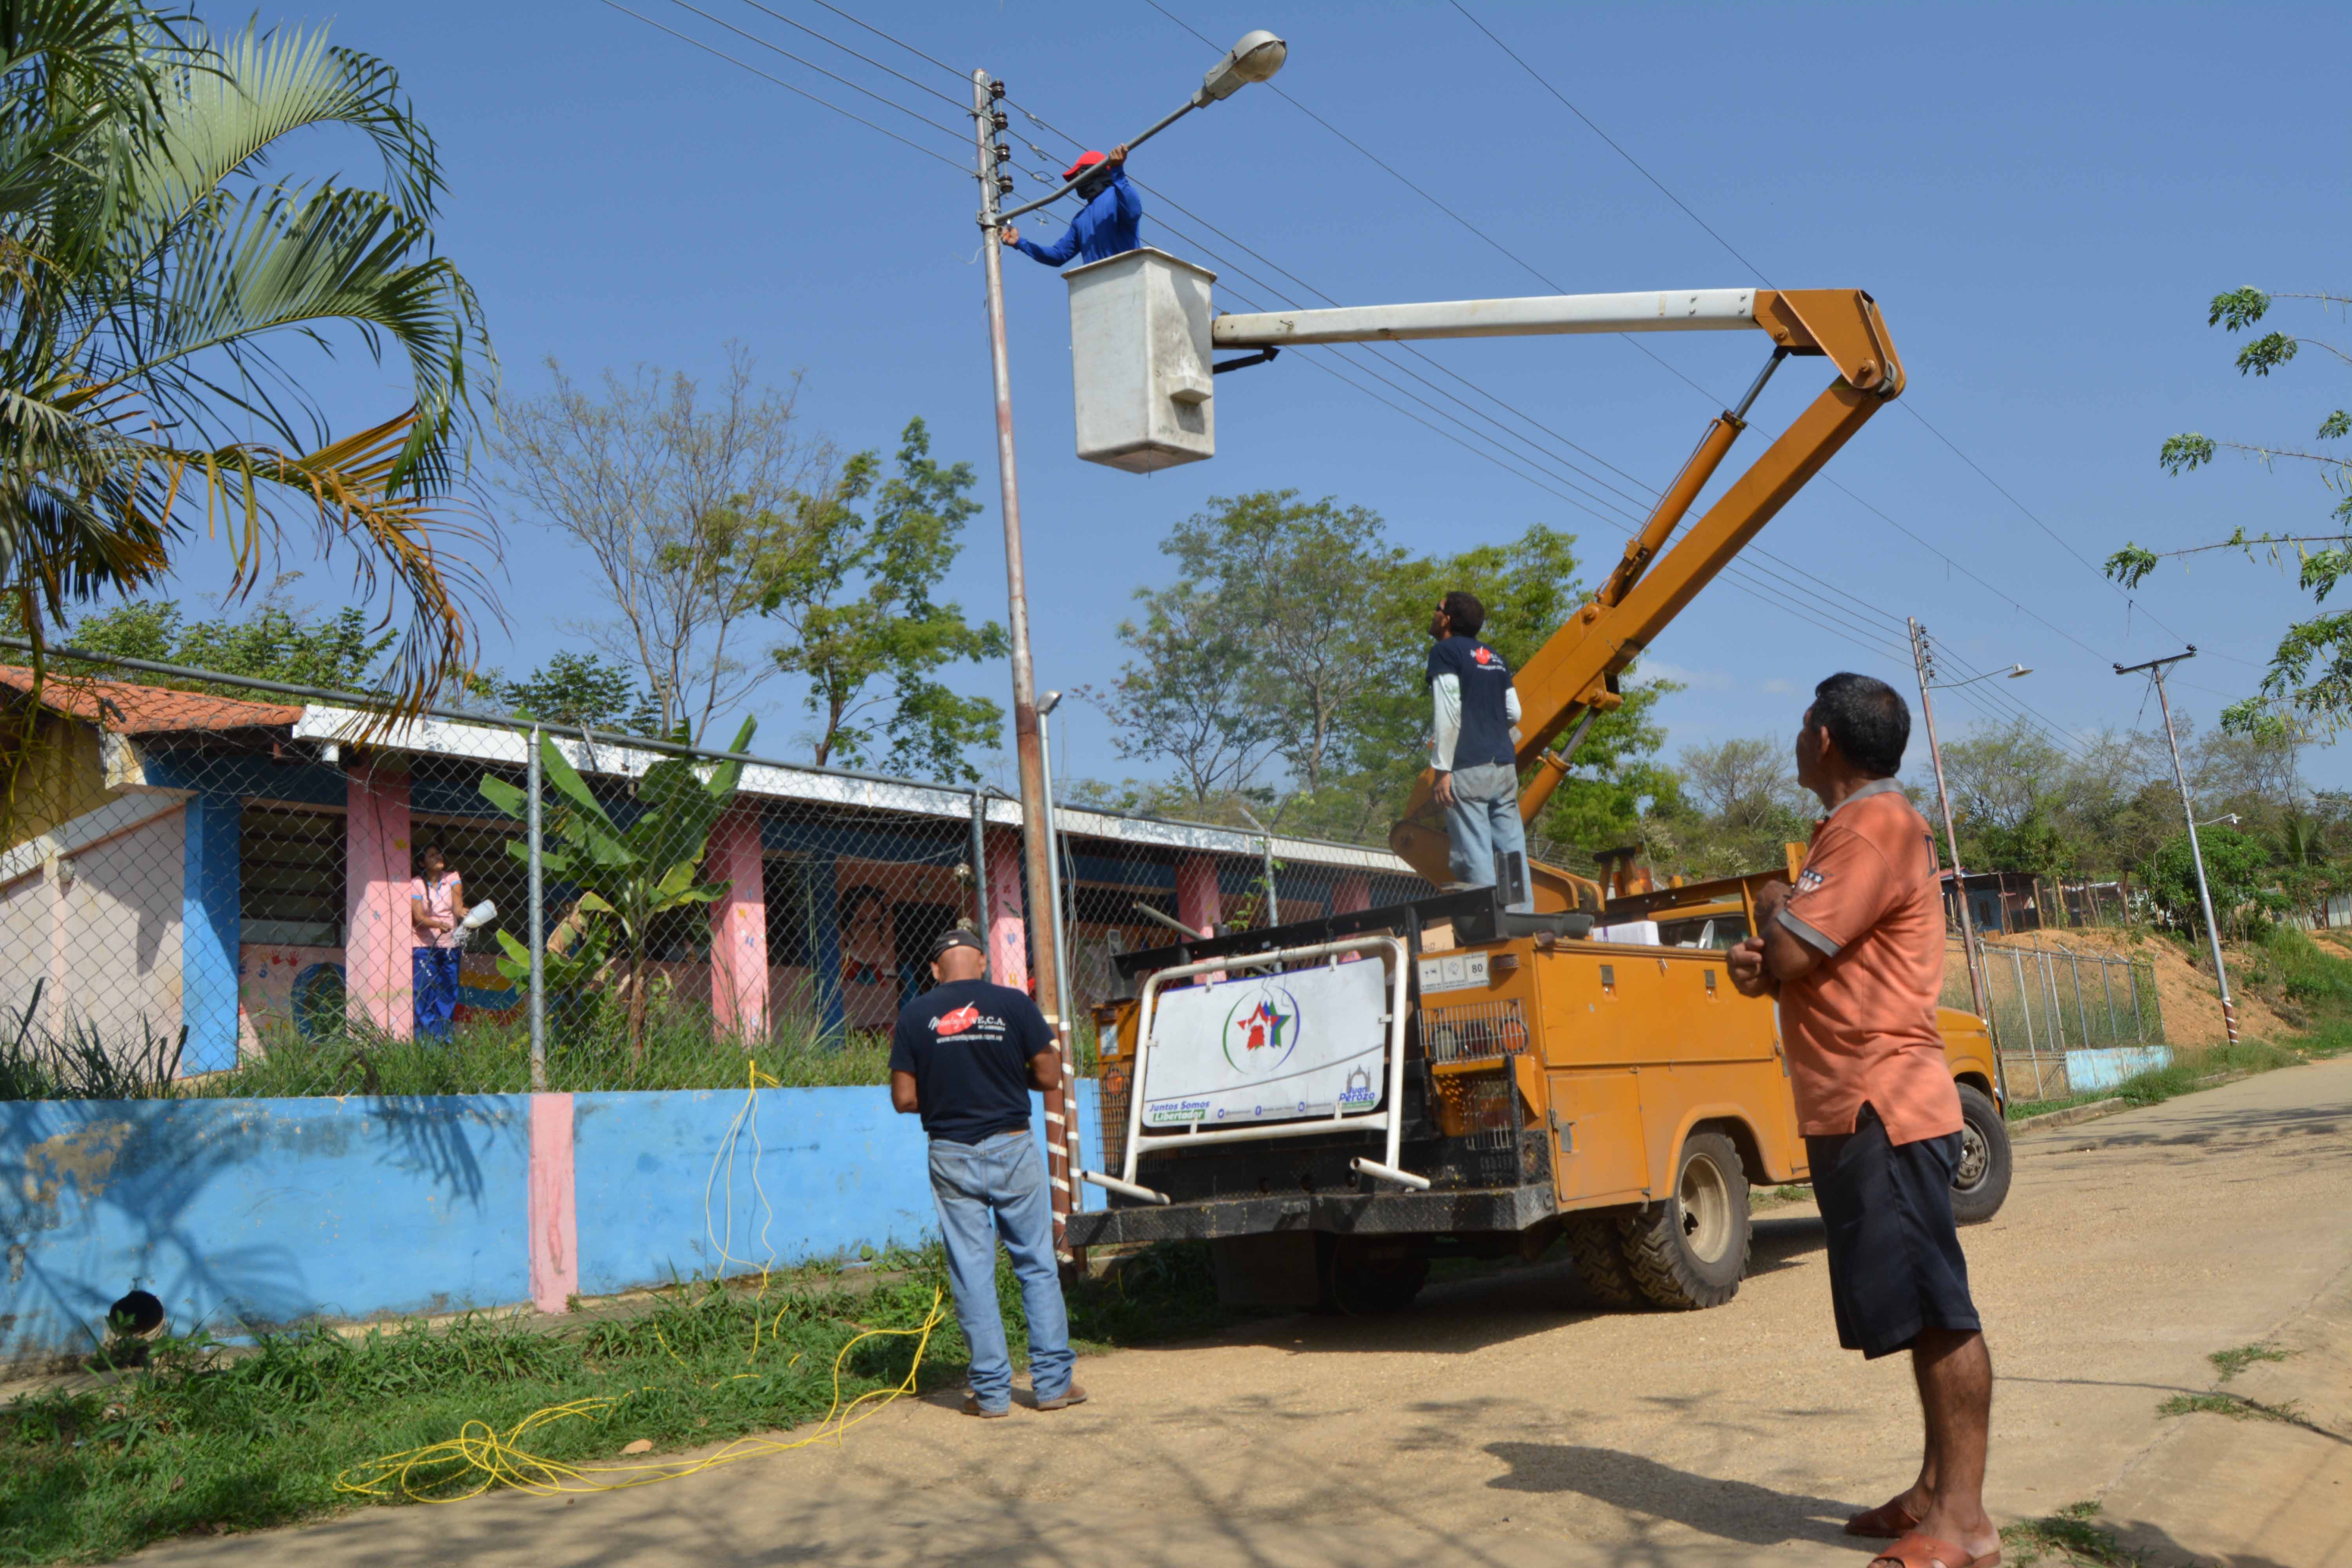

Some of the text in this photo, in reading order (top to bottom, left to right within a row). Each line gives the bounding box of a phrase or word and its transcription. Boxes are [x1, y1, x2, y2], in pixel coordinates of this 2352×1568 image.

[1472, 963, 1483, 974] 80
[1348, 1085, 1368, 1094] Juan
[1339, 1092, 1375, 1103] Perozo
[1149, 1101, 1210, 1112] Juntos Somos
[1154, 1110, 1203, 1122] Libertador
